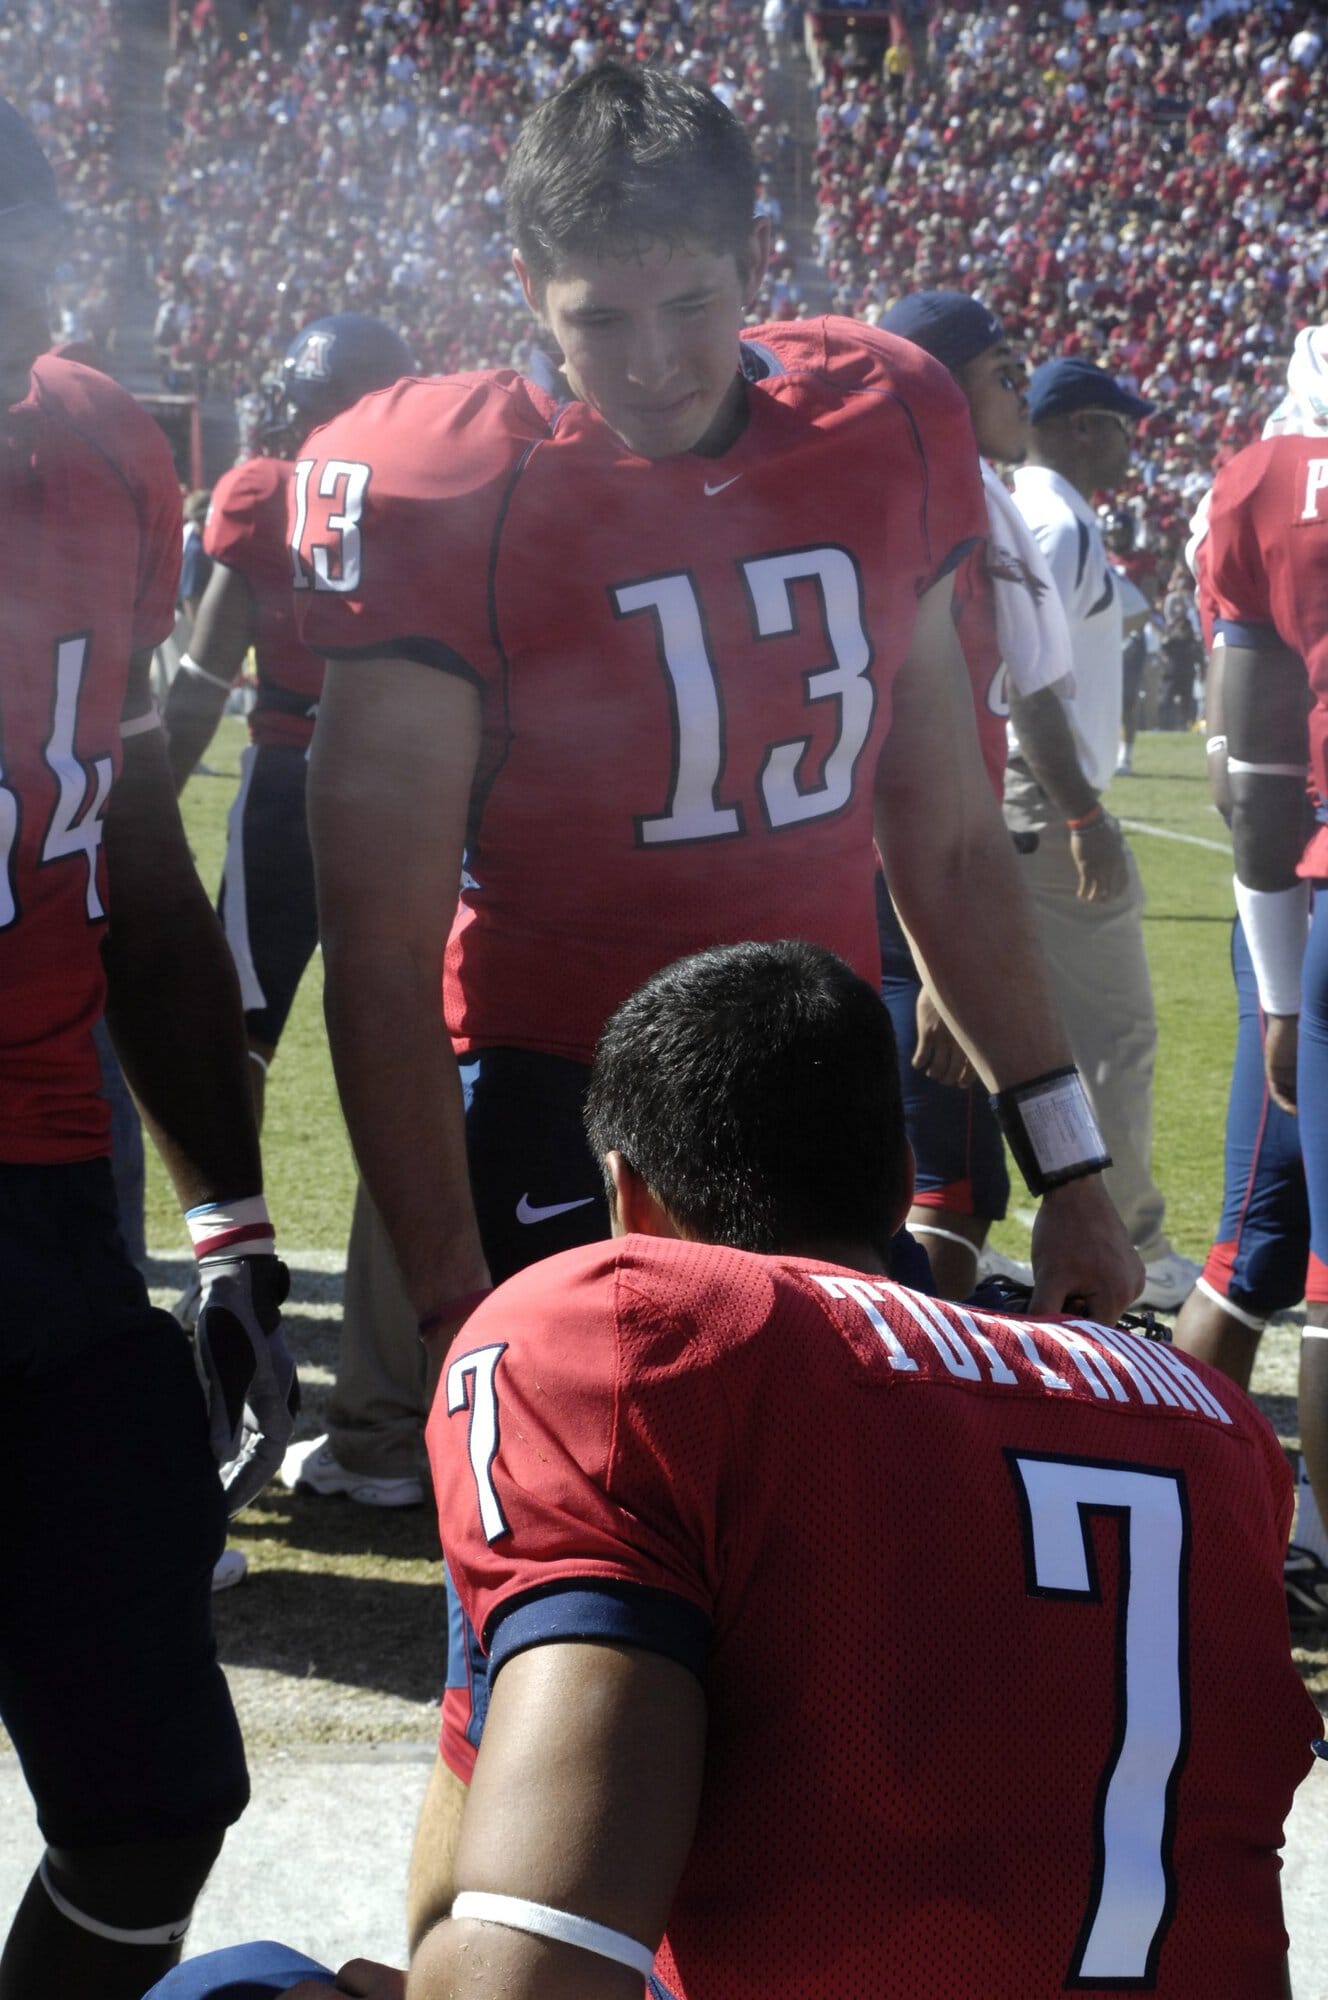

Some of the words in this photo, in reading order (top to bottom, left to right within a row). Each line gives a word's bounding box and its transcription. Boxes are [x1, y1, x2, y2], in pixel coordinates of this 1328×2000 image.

[293, 459, 371, 592] 13
[609, 543, 877, 847] 13
[446, 1342, 511, 1546] 7
[808, 1274, 1234, 1425] TUITAMA
[1002, 1448, 1192, 1990] 7
